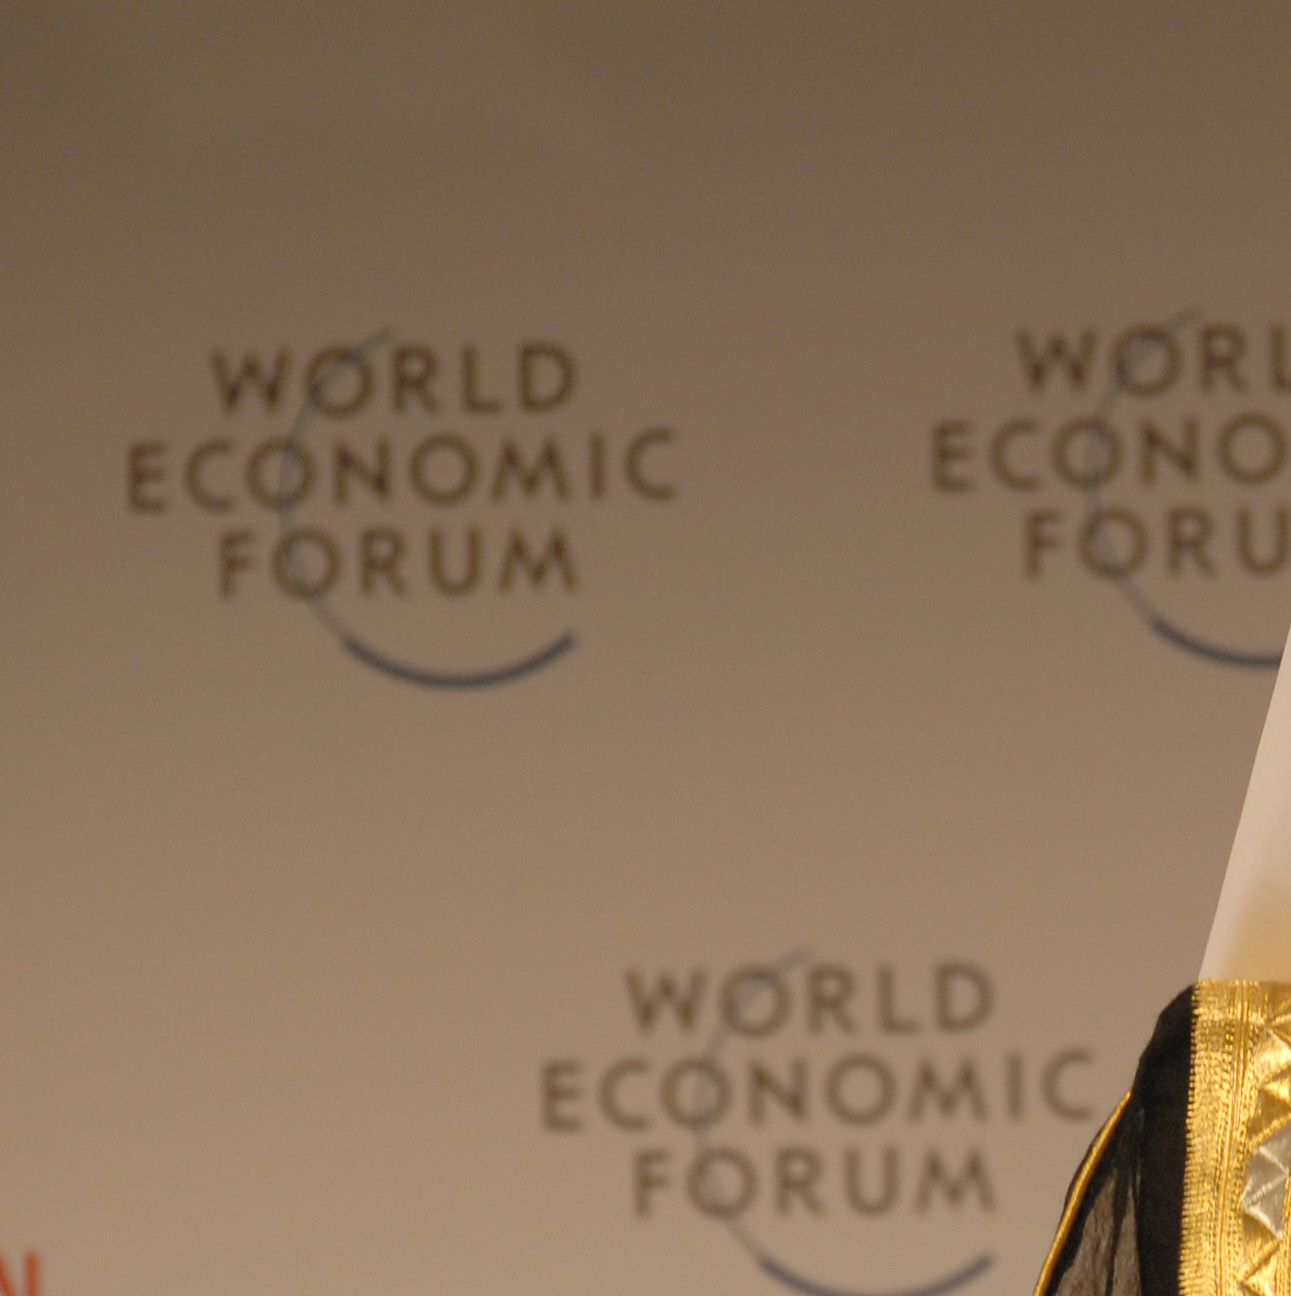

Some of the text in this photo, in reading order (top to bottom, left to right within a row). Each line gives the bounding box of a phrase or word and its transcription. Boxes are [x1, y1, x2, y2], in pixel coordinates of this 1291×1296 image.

[211, 341, 578, 419] WORLD
[127, 427, 678, 514] ECONOMIC
[217, 525, 580, 600] FORUM
[624, 960, 995, 1038] WORLD
[540, 1047, 1097, 1132] ECONOMIC
[632, 1145, 997, 1222] FORUM
